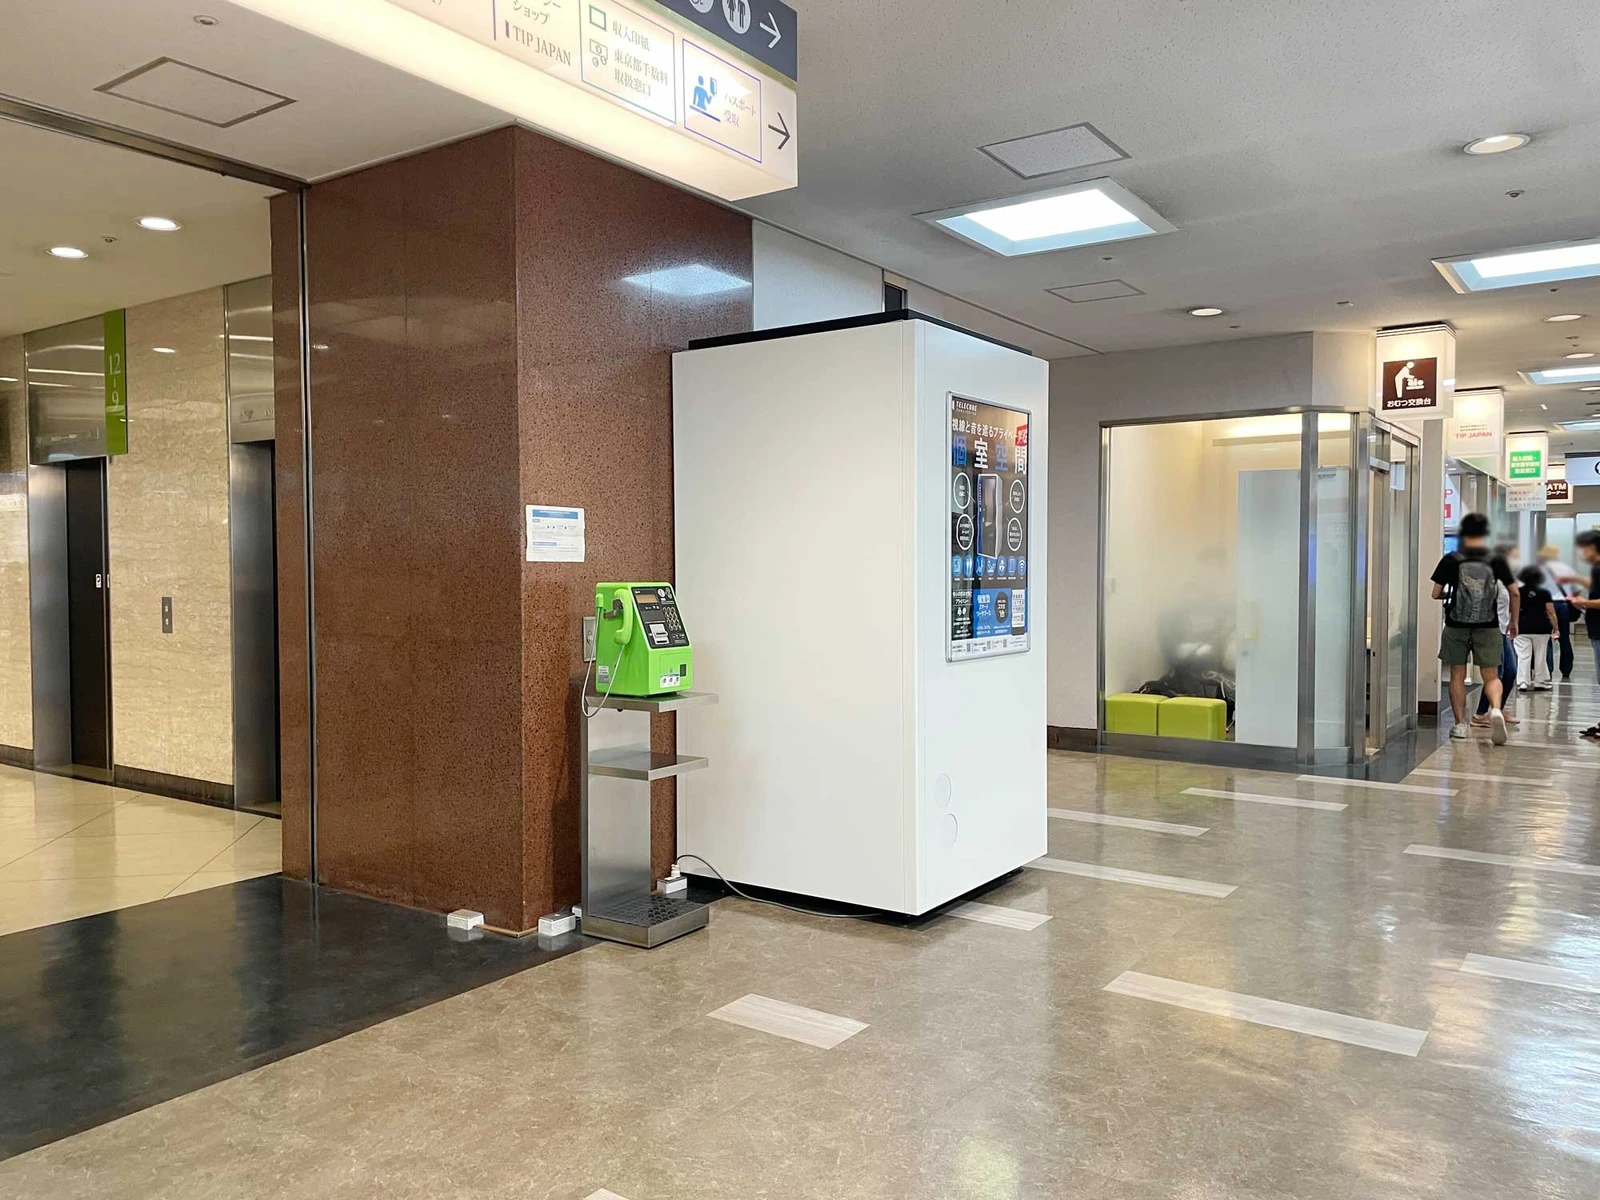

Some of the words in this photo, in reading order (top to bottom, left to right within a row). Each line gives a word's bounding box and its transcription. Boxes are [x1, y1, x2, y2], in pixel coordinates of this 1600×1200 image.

[513, 0, 550, 25] ショップ
[513, 25, 534, 47] TIP
[535, 36, 571, 66] JAPAN
[612, 20, 650, 52] 収入印紙
[614, 48, 668, 86] 東京都手数料
[614, 68, 651, 97] 取扱窓口
[109, 353, 121, 375] 12
[112, 390, 119, 412] 9
[1386, 397, 1432, 408] おむつ交換台
[1455, 432, 1467, 440] TIP
[1468, 430, 1493, 438] JAPAN
[1547, 483, 1567, 491] ATM
